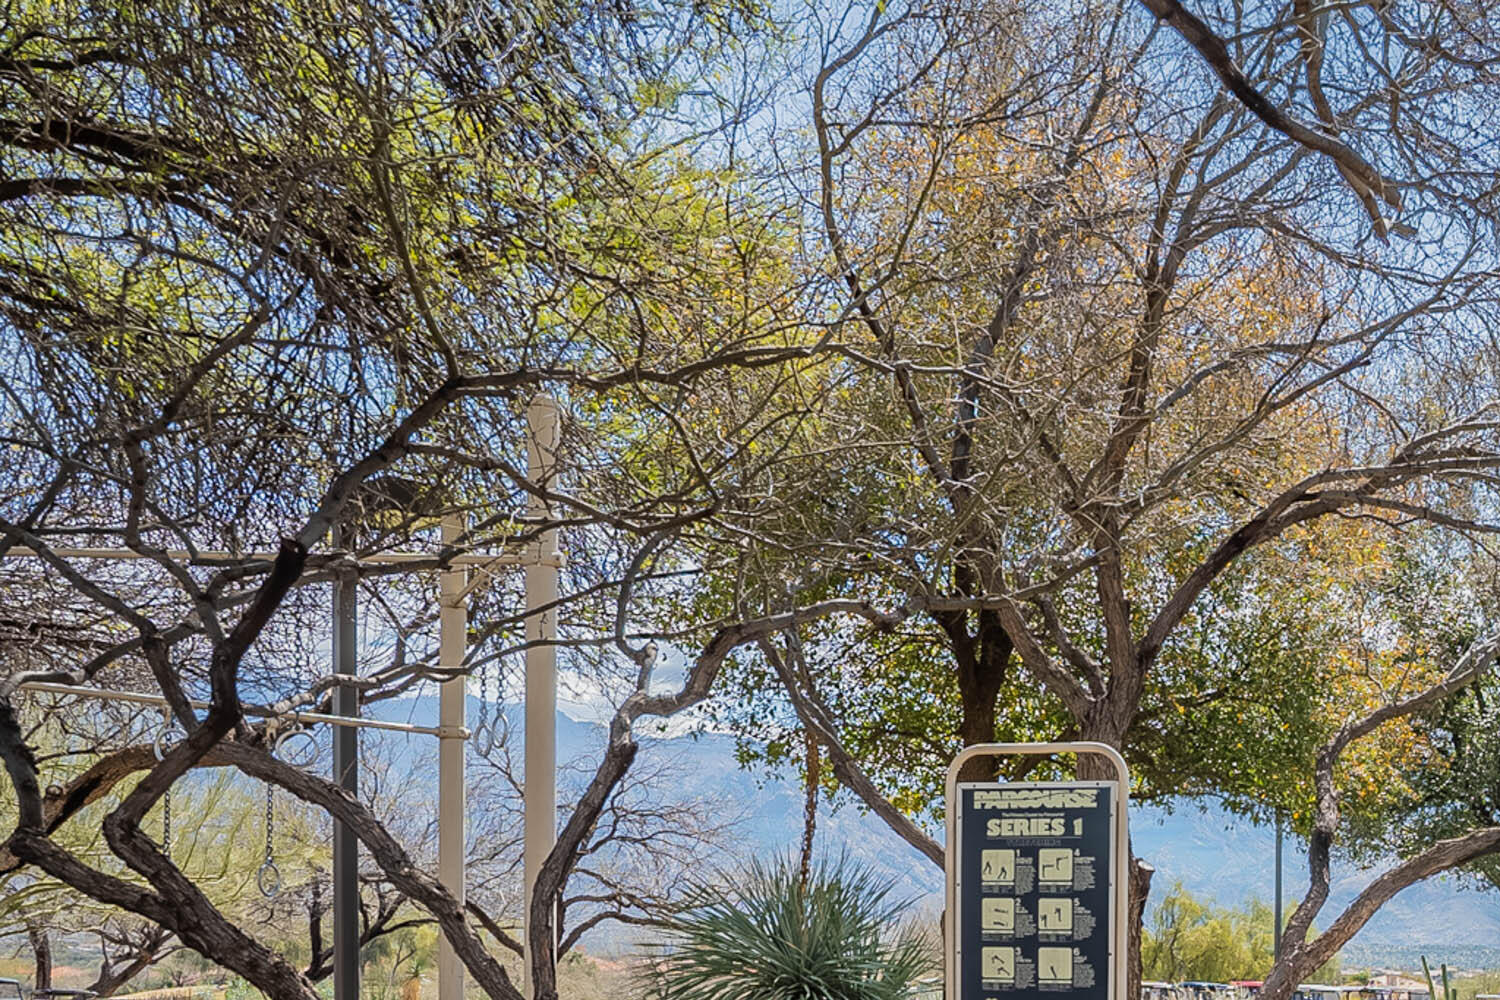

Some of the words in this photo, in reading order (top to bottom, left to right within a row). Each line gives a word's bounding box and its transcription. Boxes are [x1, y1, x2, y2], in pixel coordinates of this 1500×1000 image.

[973, 789, 1098, 809] PARCOURSE
[986, 817, 1066, 837] SERIES
[1072, 817, 1083, 836] 1
